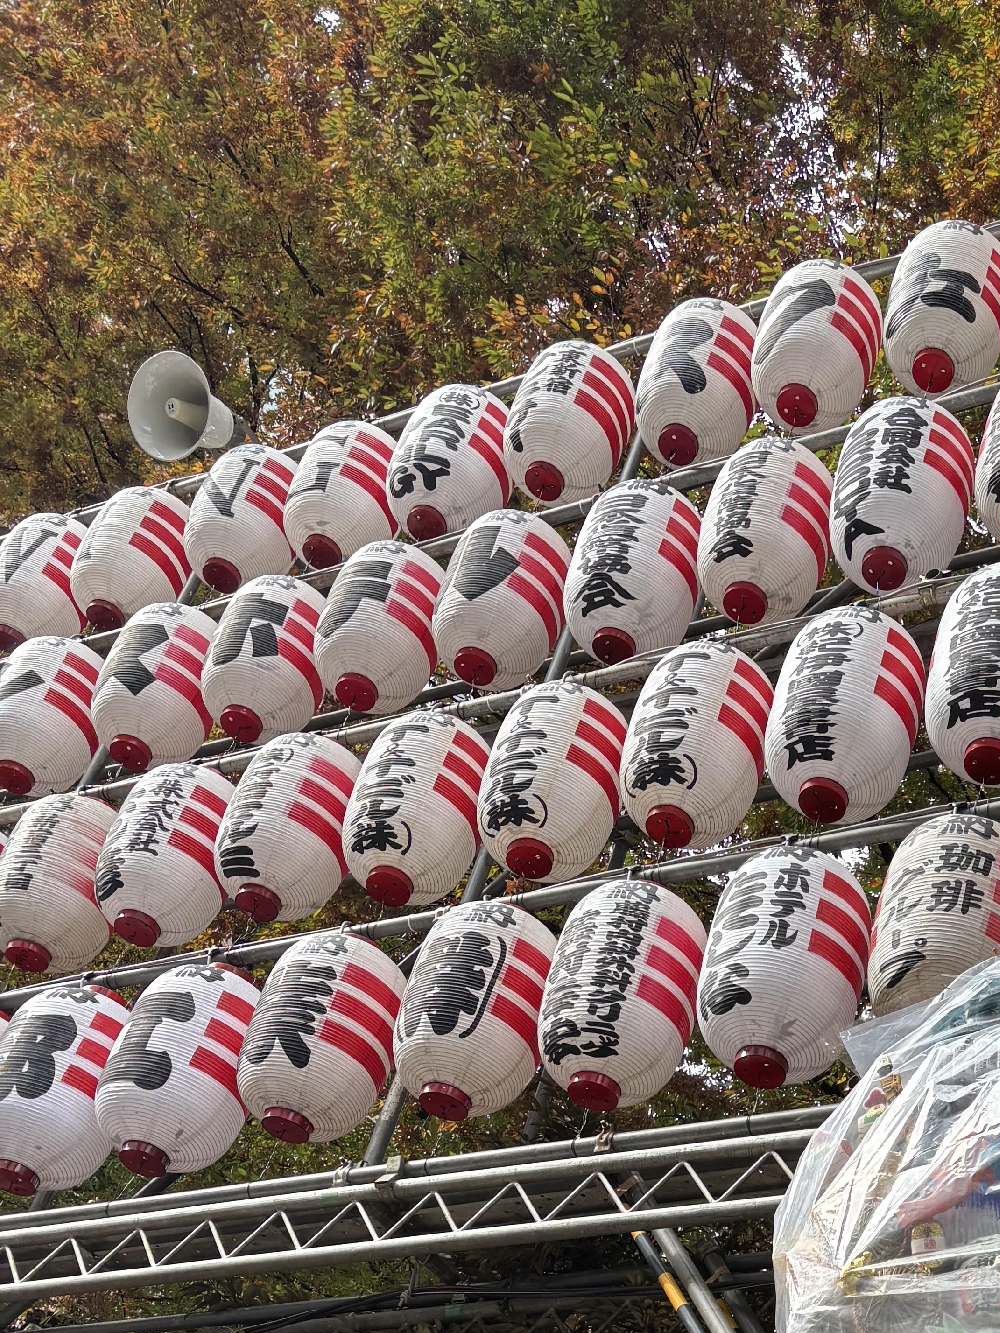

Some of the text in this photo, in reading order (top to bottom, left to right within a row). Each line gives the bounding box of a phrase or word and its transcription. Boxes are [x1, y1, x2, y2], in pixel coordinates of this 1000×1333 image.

[872, 407, 930, 496] 合同会社
[126, 778, 187, 857] 株式会社
[757, 862, 811, 950] ホテル
[925, 842, 996, 915] 珈琲
